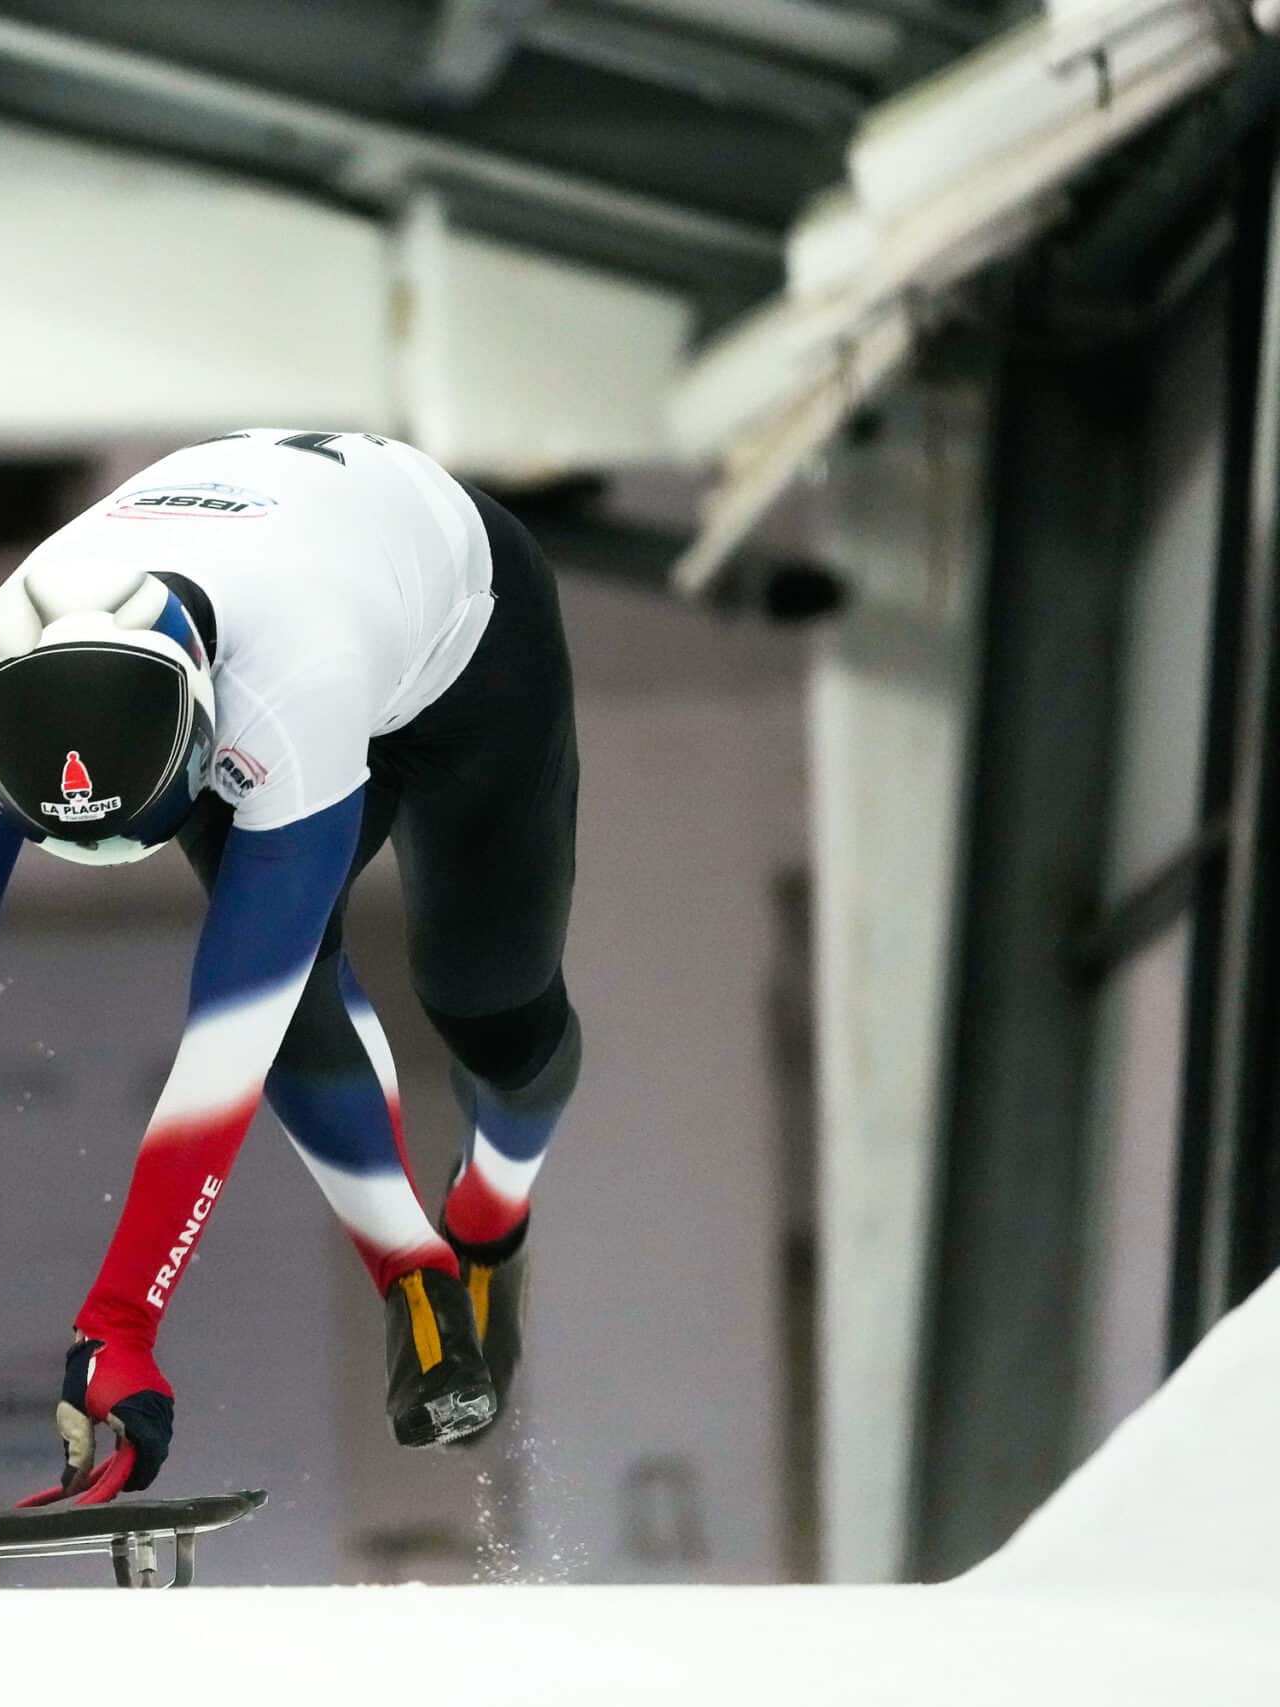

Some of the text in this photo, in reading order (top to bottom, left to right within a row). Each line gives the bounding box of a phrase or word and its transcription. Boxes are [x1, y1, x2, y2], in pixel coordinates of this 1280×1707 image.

[133, 495, 250, 513] IBSF
[42, 799, 119, 815] LA PLAGNE
[145, 1174, 224, 1310] FRANCE
